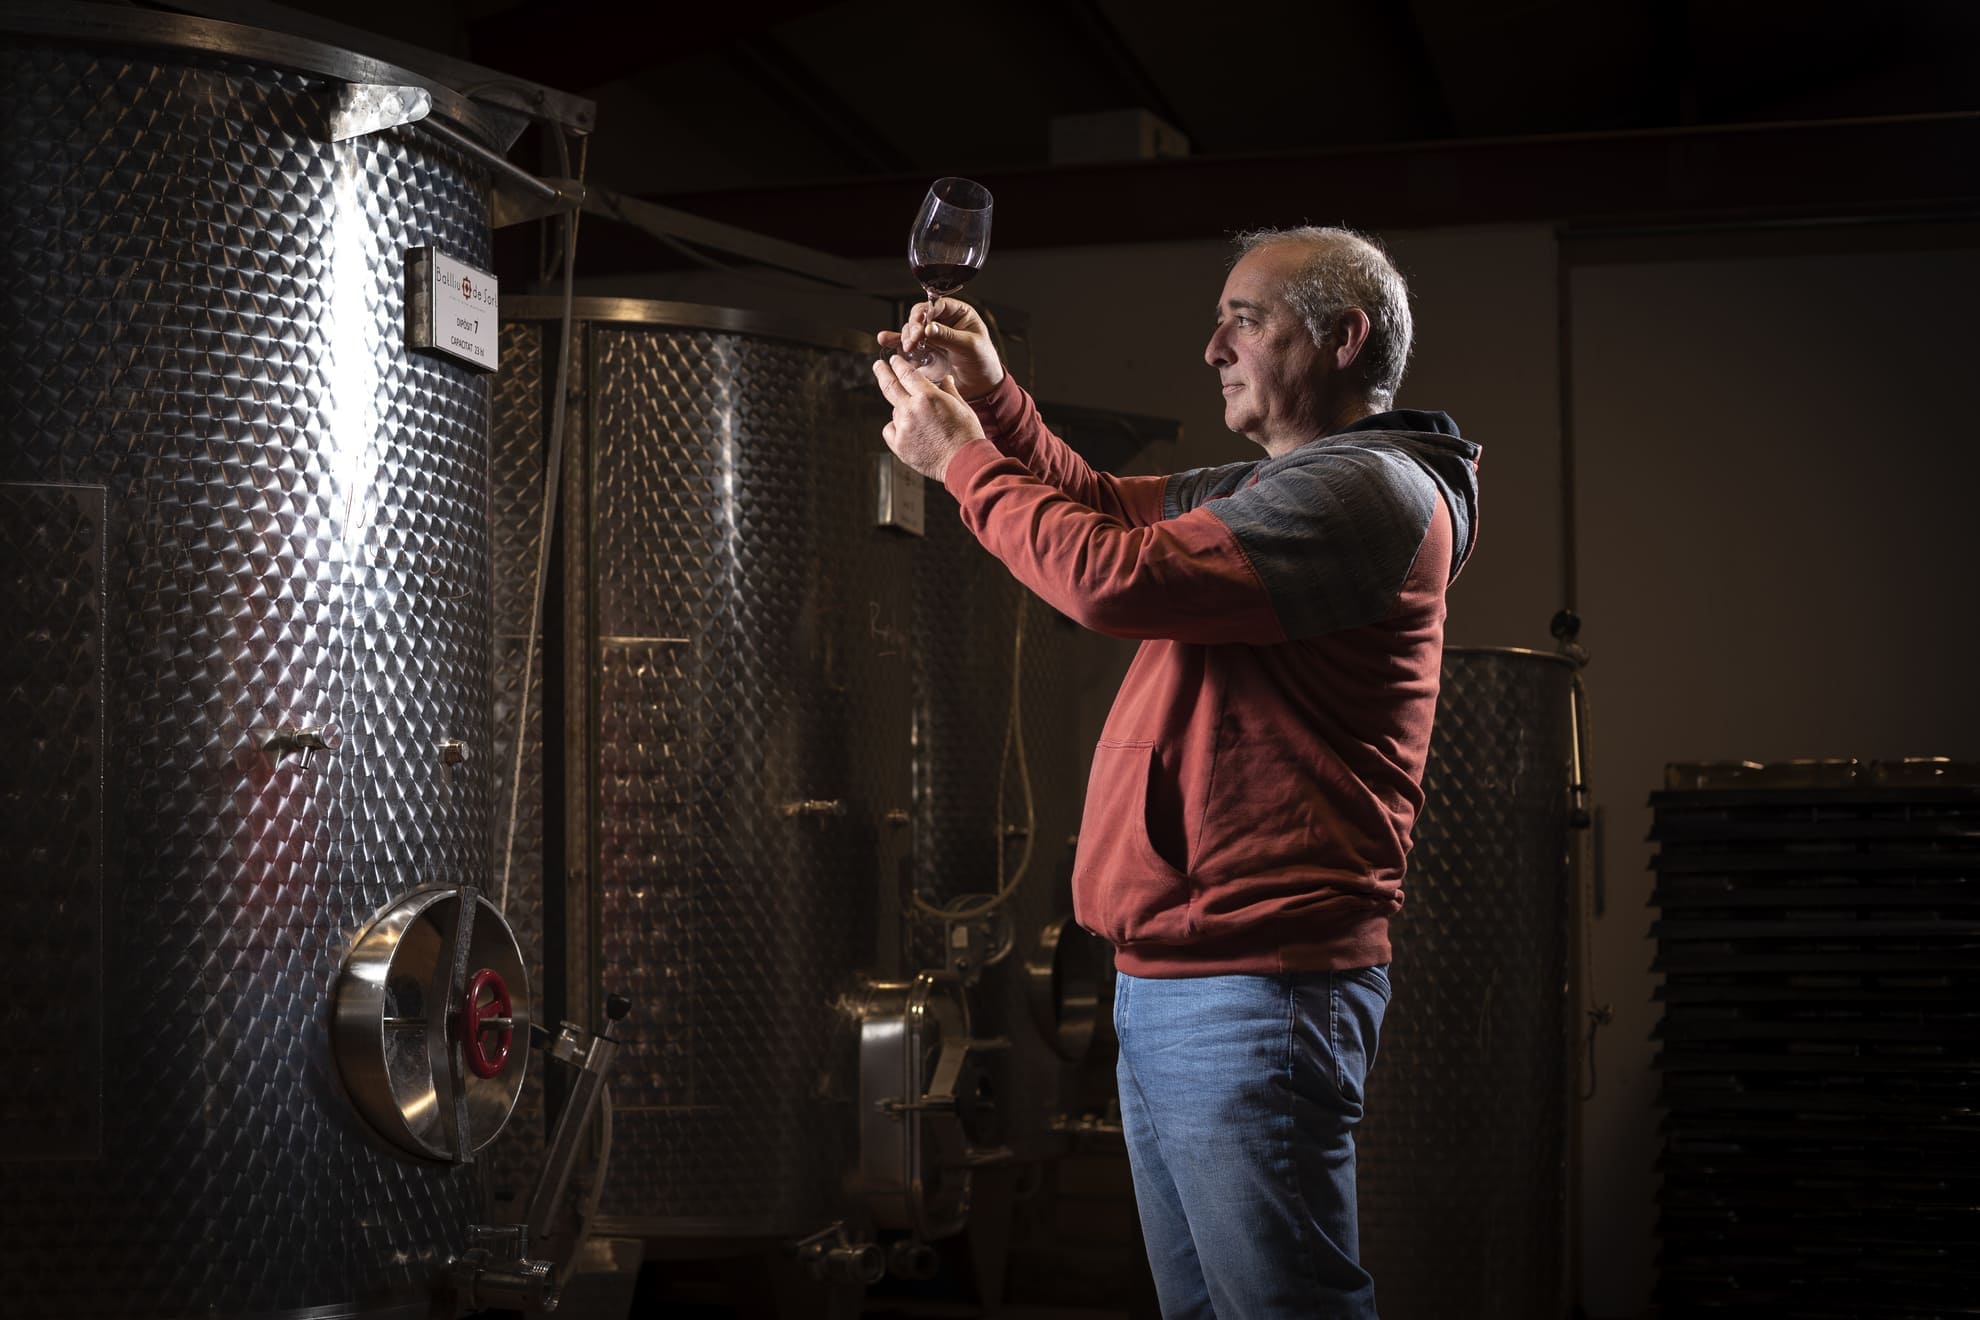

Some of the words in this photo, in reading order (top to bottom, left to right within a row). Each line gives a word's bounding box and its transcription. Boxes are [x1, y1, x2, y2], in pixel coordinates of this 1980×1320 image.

[472, 284, 482, 301] de
[474, 320, 479, 334] 7
[451, 335, 473, 352] CAPACITAT
